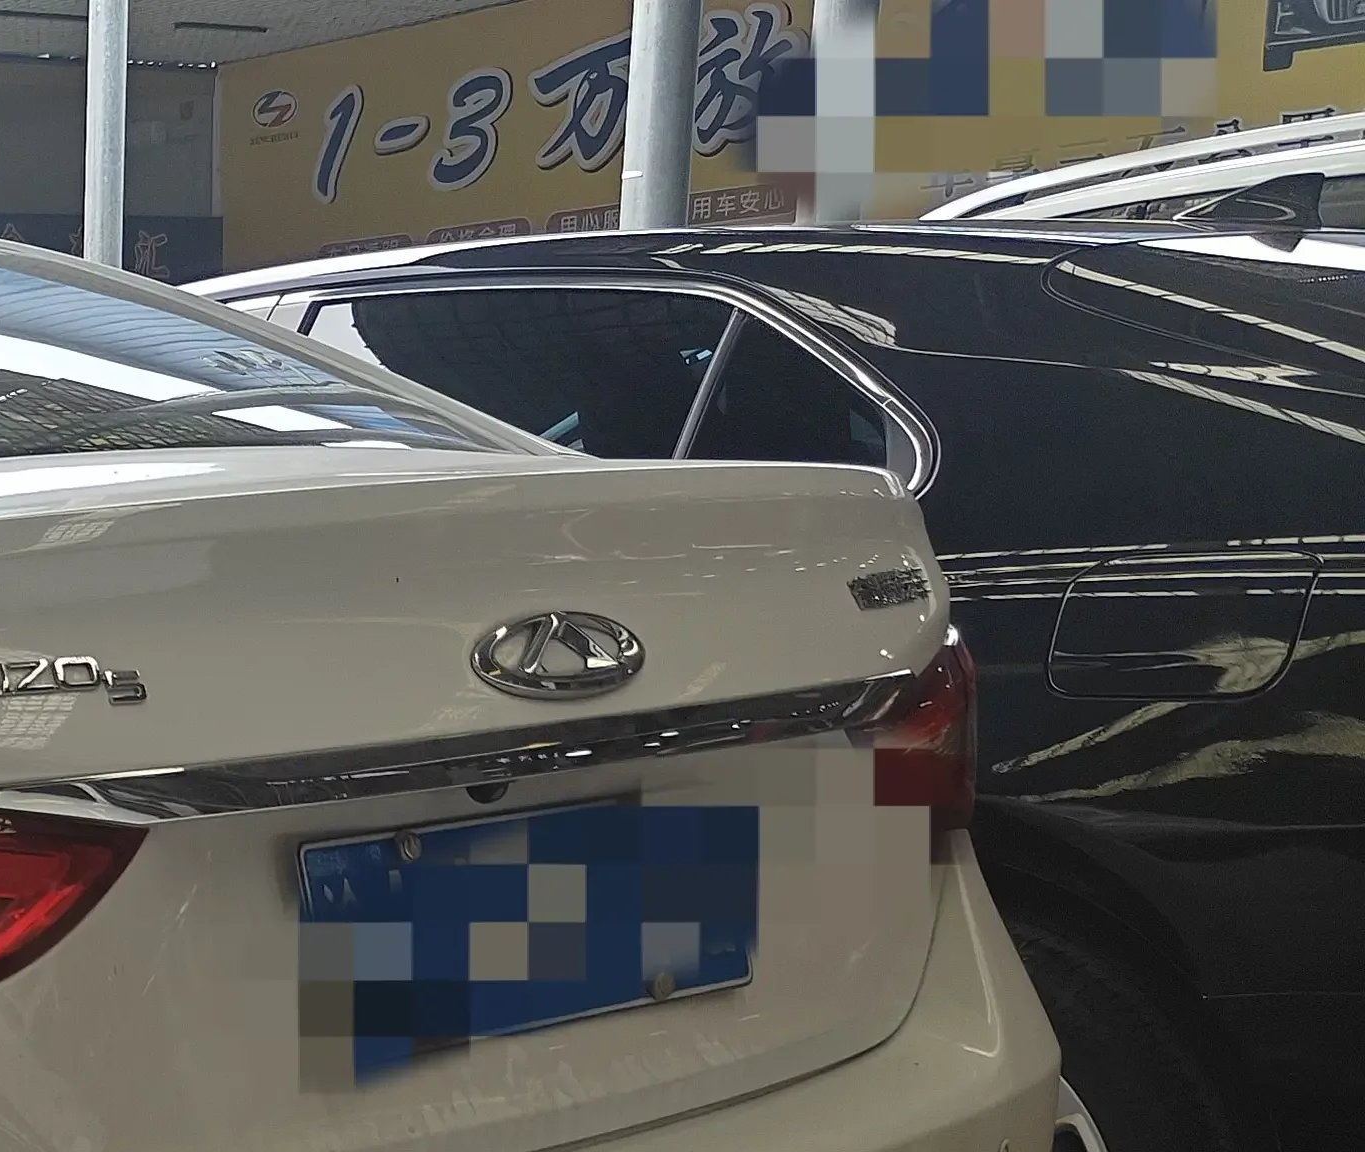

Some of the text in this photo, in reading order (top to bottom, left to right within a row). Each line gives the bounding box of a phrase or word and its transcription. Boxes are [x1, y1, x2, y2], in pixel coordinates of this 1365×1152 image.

[692, 188, 785, 220] 用车安心
[102, 669, 147, 706] 5
